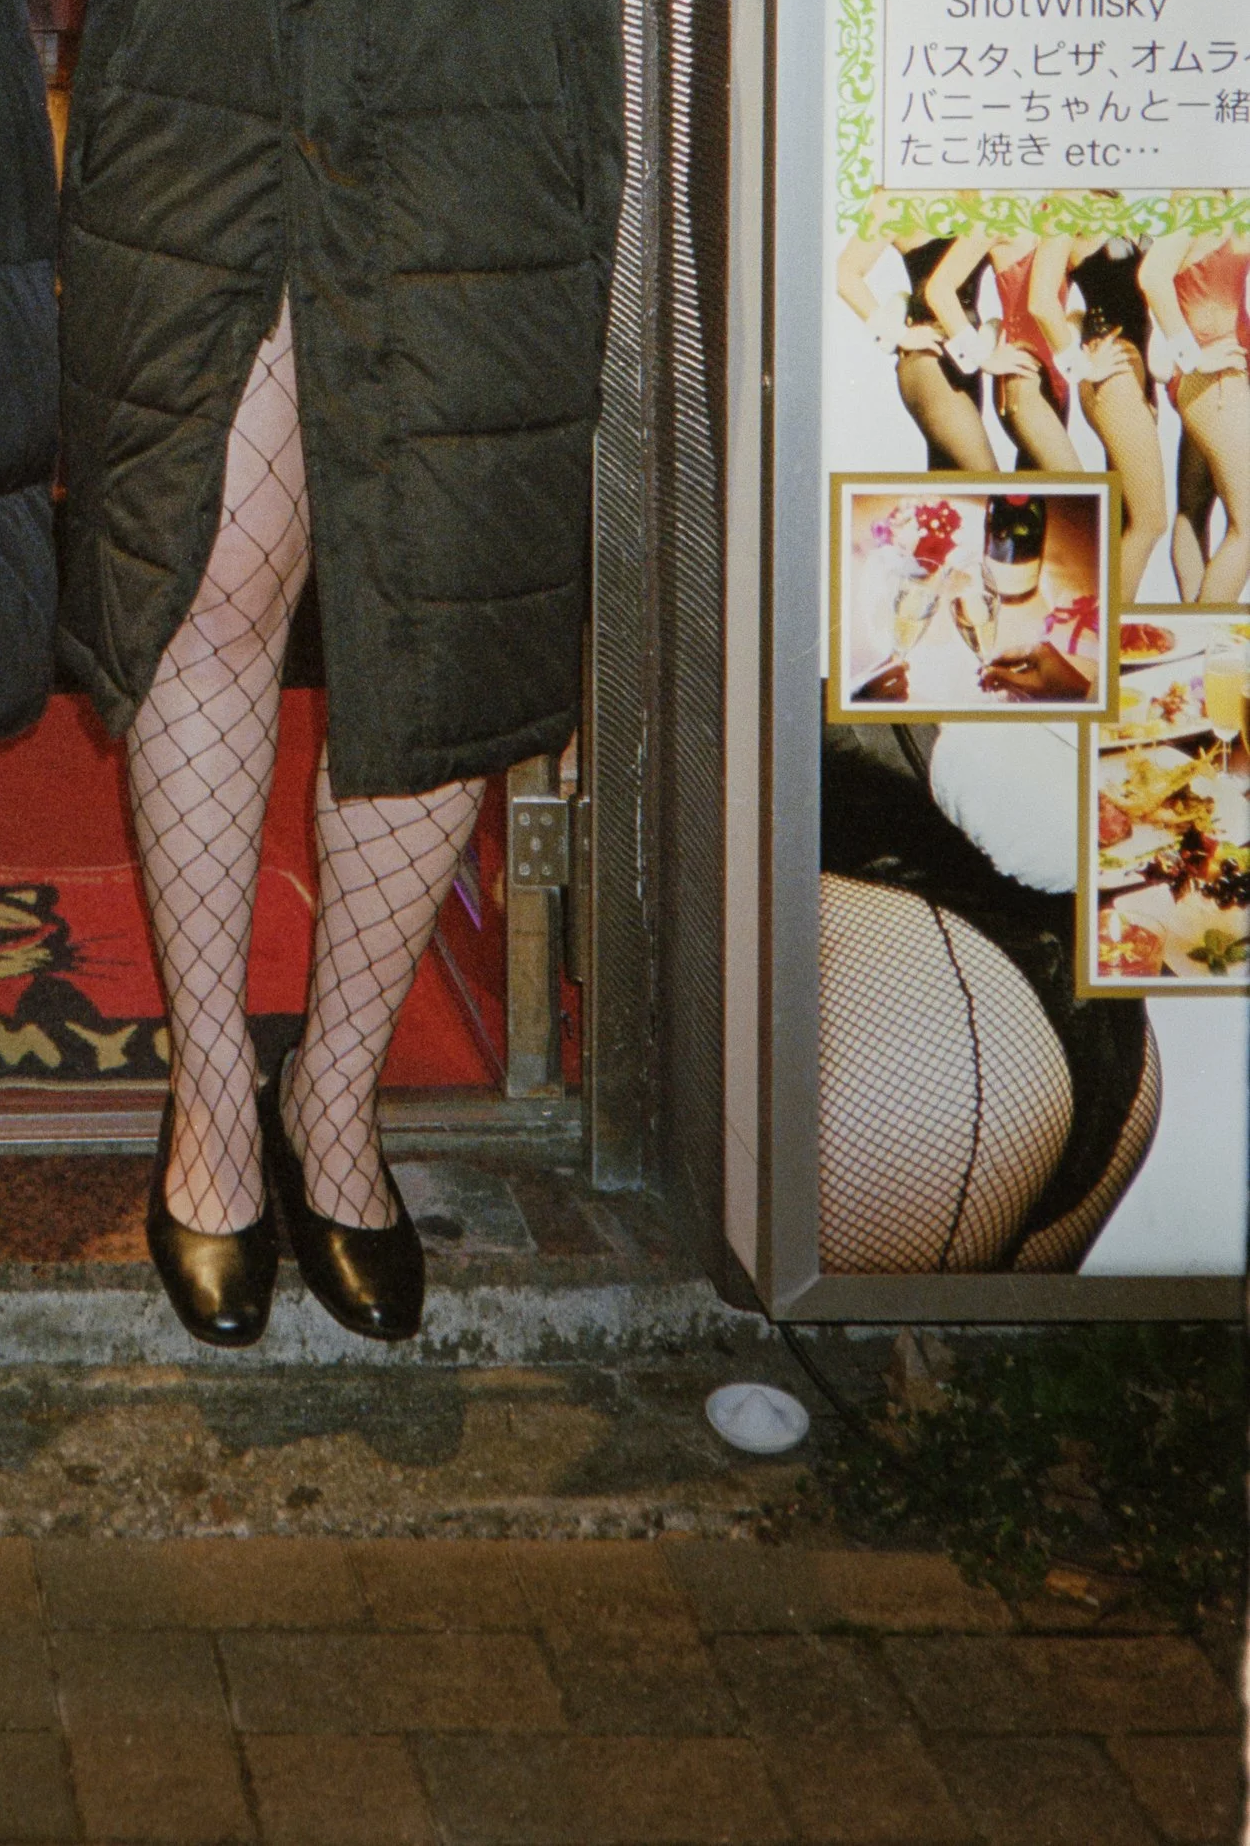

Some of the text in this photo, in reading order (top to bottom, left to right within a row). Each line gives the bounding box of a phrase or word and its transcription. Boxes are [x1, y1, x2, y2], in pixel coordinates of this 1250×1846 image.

[902, 39, 1250, 78] パスタ、ピザ、オムラ
[900, 132, 1050, 167] たこ焼き
